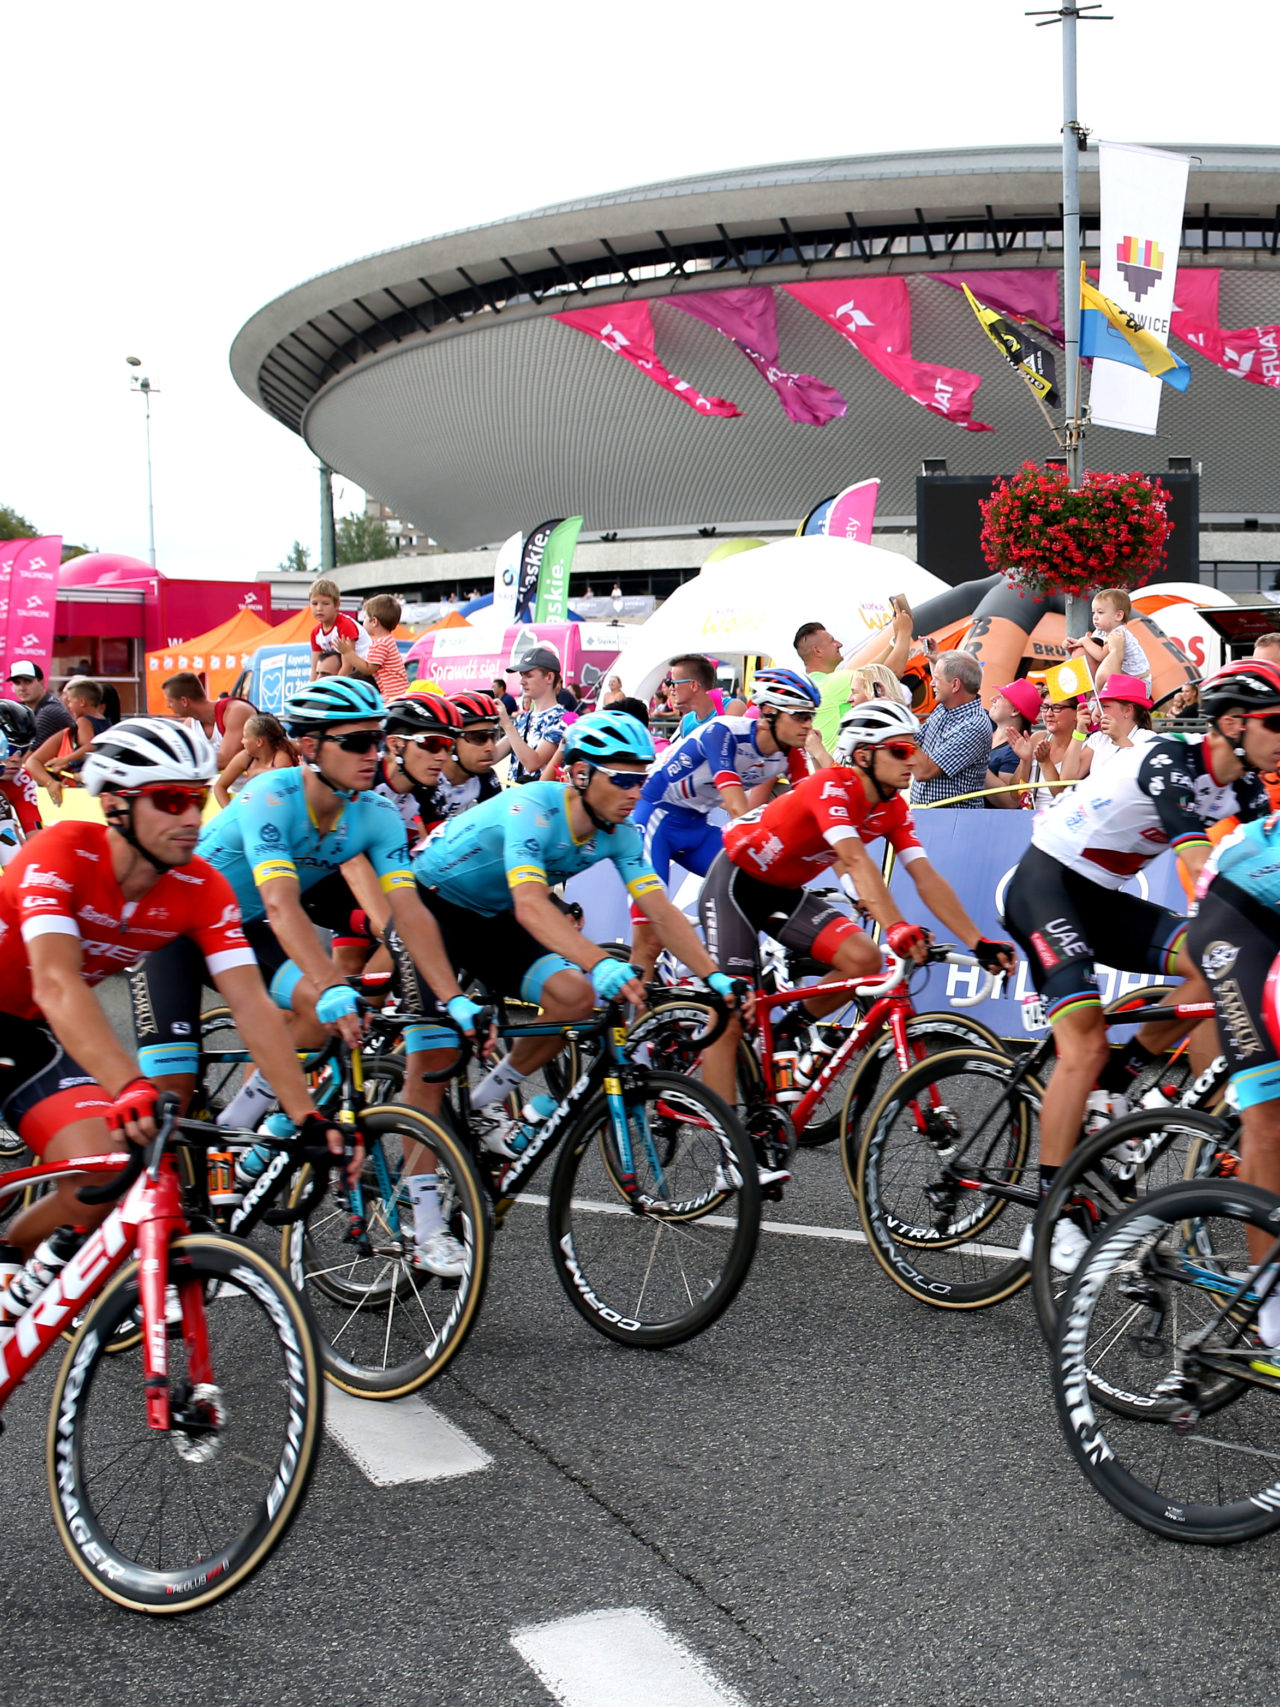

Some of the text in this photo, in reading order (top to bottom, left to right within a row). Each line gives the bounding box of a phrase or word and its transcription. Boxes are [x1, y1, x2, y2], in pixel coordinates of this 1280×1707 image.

[845, 516, 861, 541] ety
[20, 569, 53, 581] TAURON
[17, 607, 49, 619] TAURON
[14, 647, 46, 657] TAURON
[1032, 642, 1066, 657] BRU
[429, 658, 500, 683] Sprawdź się!
[1044, 917, 1090, 957] UAE
[1219, 977, 1266, 1058] SAMRUK
[560, 1231, 641, 1332] CORIMA
[55, 1327, 126, 1581] BONTRAGER
